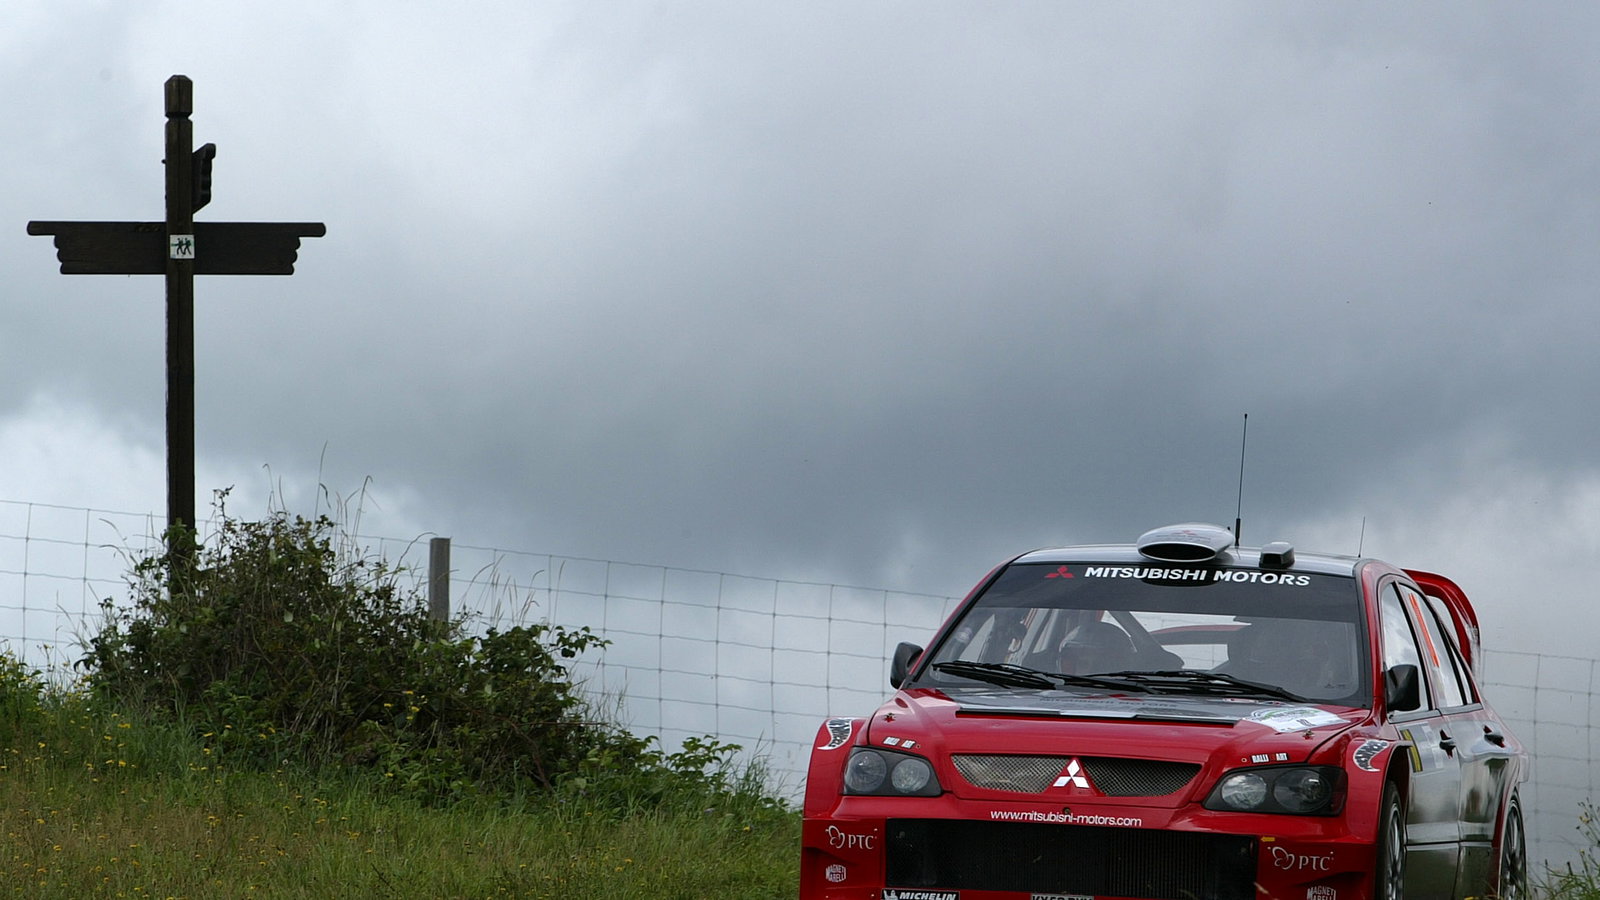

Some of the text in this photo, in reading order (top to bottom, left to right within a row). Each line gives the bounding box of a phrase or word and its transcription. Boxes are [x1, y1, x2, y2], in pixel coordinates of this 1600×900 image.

[1084, 566, 1311, 587] MITSUBISHI MOTORS
[848, 834, 874, 850] PTC
[1298, 855, 1330, 871] PTC
[899, 891, 957, 900] MICHELIN
